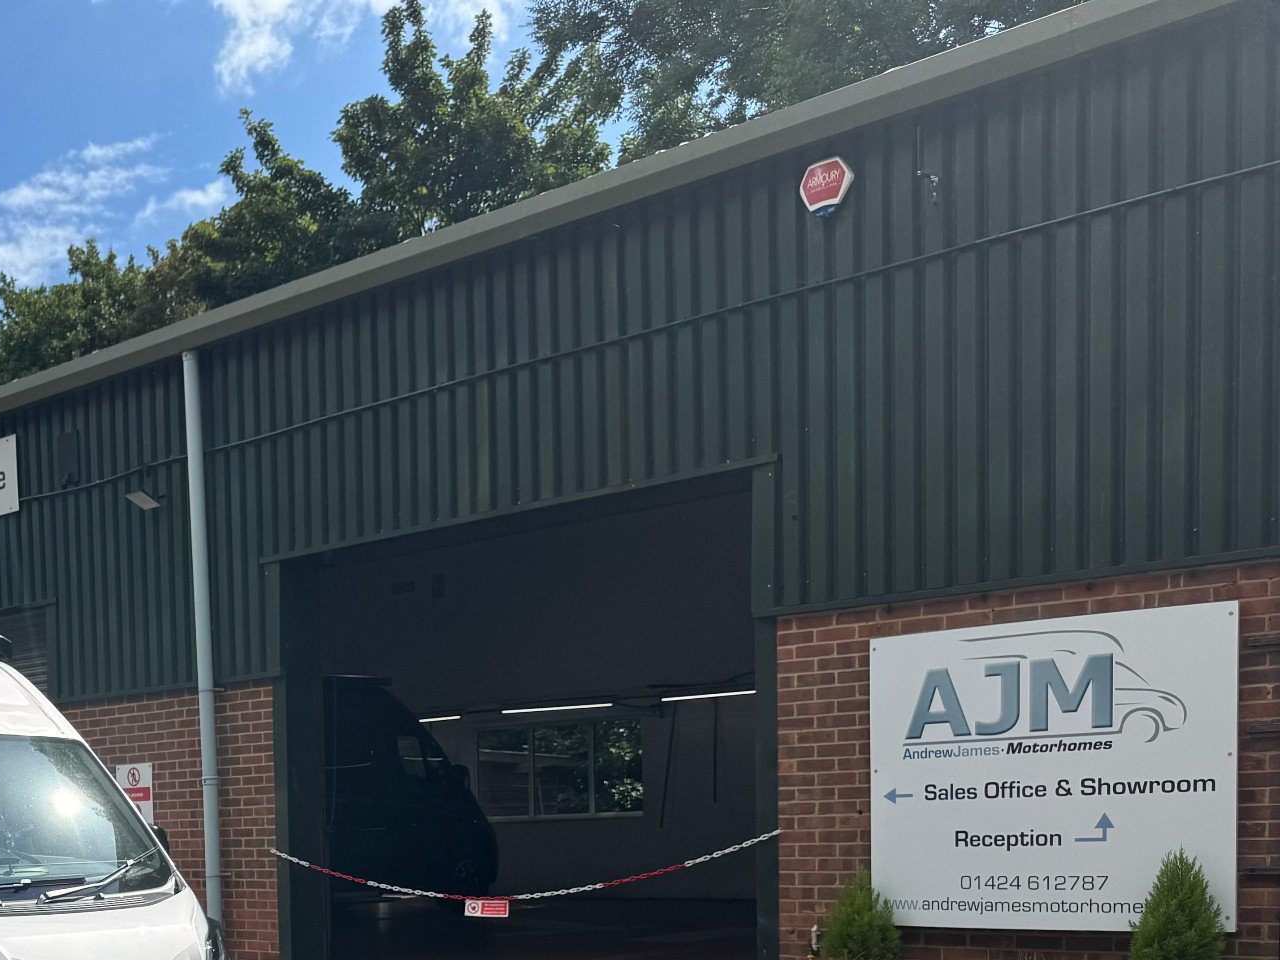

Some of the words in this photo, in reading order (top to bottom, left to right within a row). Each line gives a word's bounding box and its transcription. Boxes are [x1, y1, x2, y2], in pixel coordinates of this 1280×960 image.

[904, 653, 1115, 741] AJM
[924, 783, 978, 802] Sales
[984, 780, 1048, 800] Office
[1055, 779, 1073, 797] &
[1080, 776, 1217, 797] Showroom
[954, 829, 1062, 852] Reception
[960, 875, 1022, 891] 01424
[1027, 875, 1109, 891] 612787
[887, 897, 1144, 915] www.andrewjamesmotorhome
